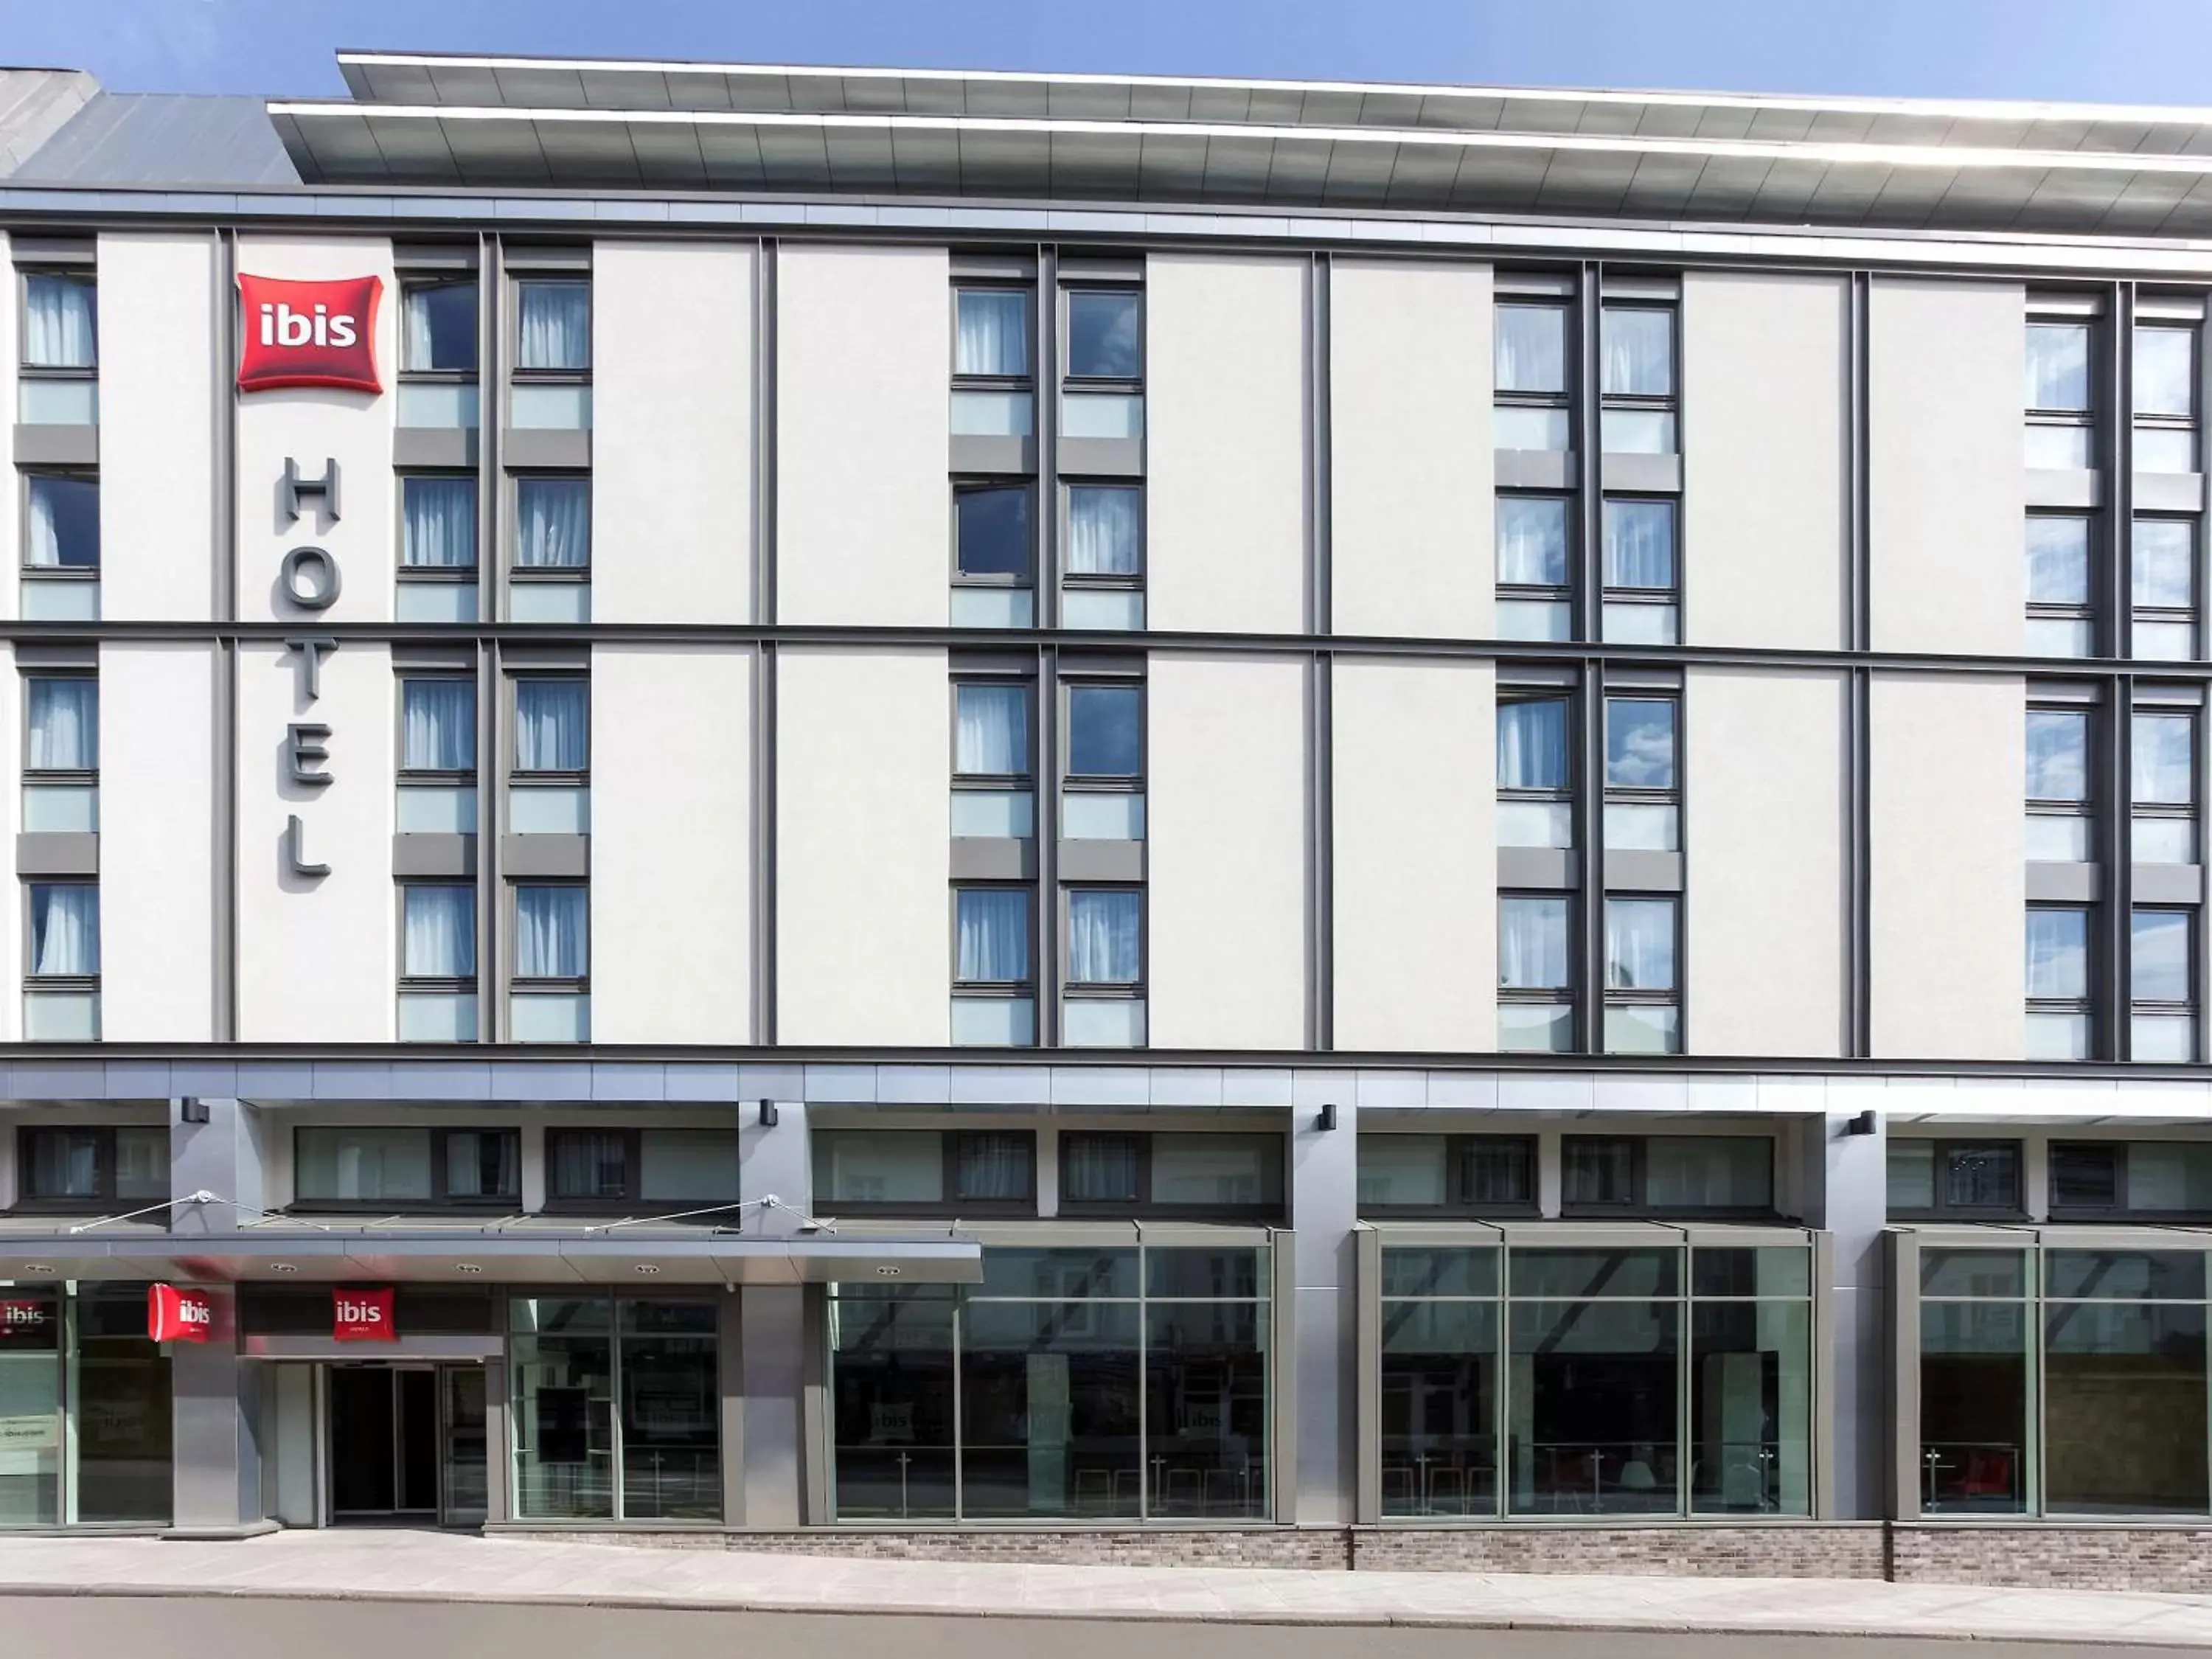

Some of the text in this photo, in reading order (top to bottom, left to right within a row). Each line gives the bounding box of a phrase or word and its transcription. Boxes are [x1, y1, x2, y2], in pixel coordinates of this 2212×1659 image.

[260, 302, 356, 348] ibis
[282, 456, 341, 877] HOTEL
[6, 1307, 44, 1324] ibis
[180, 1300, 209, 1324] ibis
[336, 1301, 381, 1322] ibis
